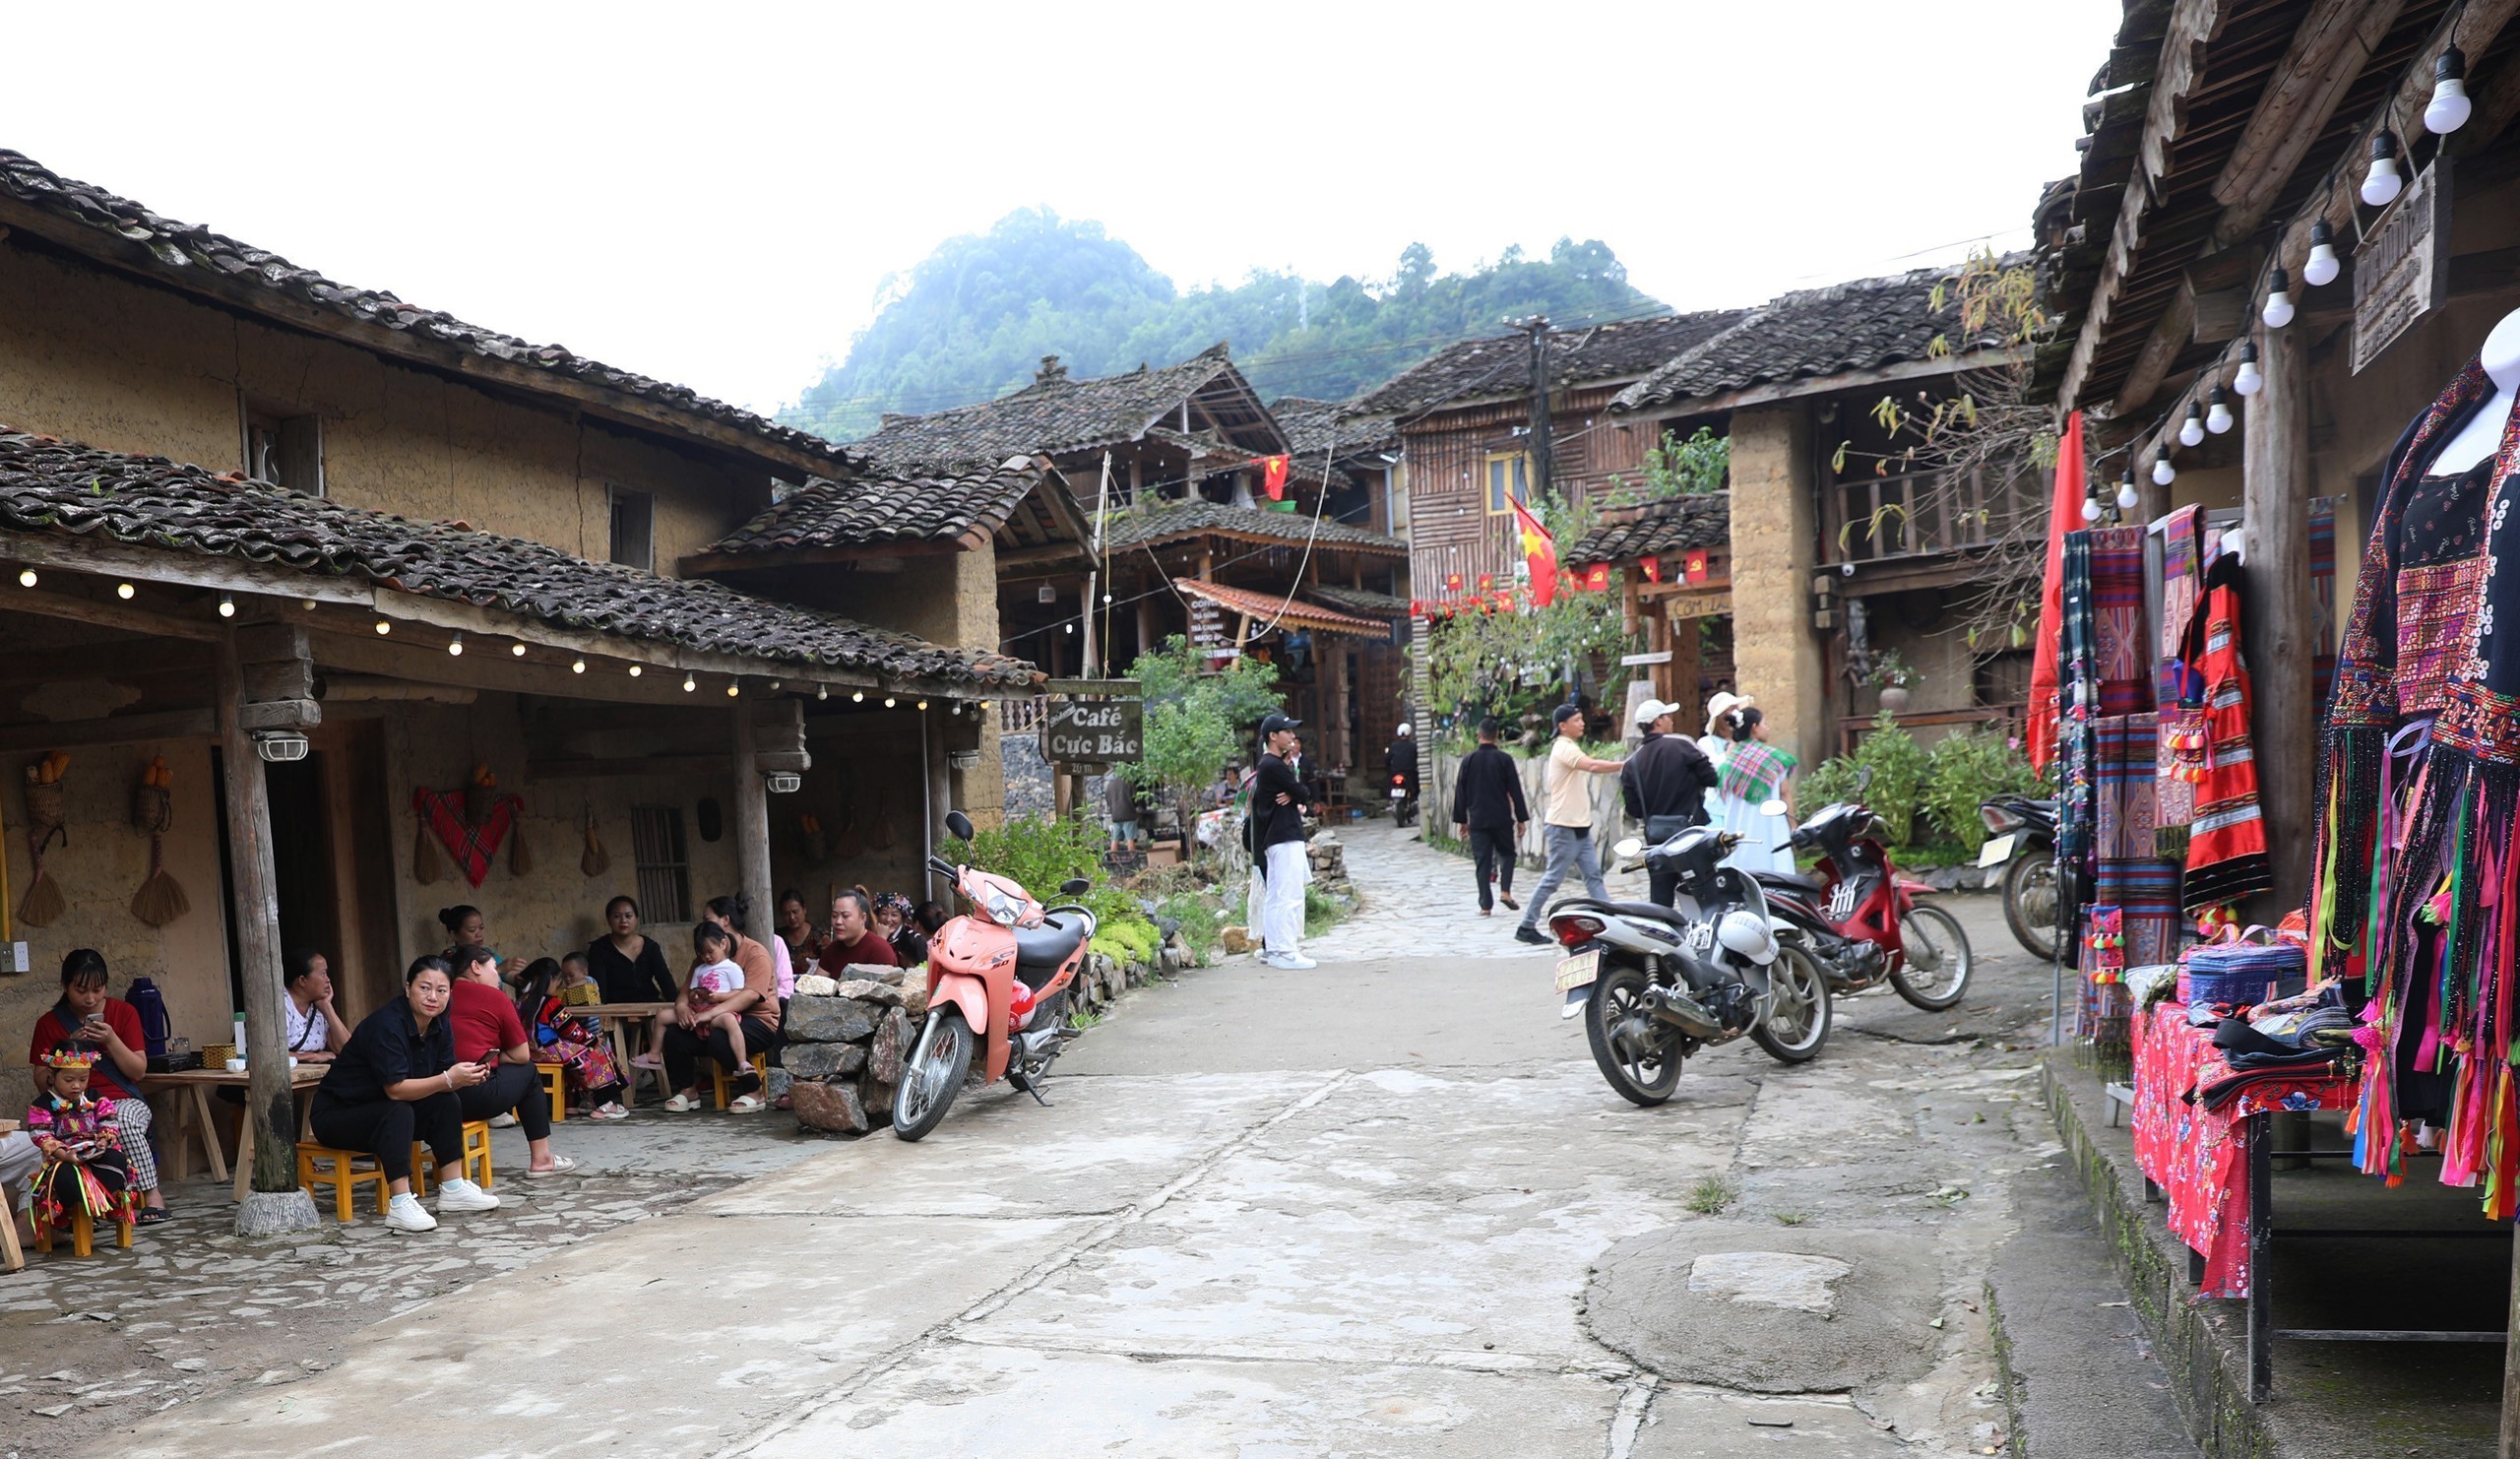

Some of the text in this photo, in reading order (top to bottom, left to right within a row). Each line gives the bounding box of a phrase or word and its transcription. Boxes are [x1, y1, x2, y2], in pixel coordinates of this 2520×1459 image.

[1072, 706, 1122, 727] Café
[1051, 730, 1139, 759] Cực Bắc
